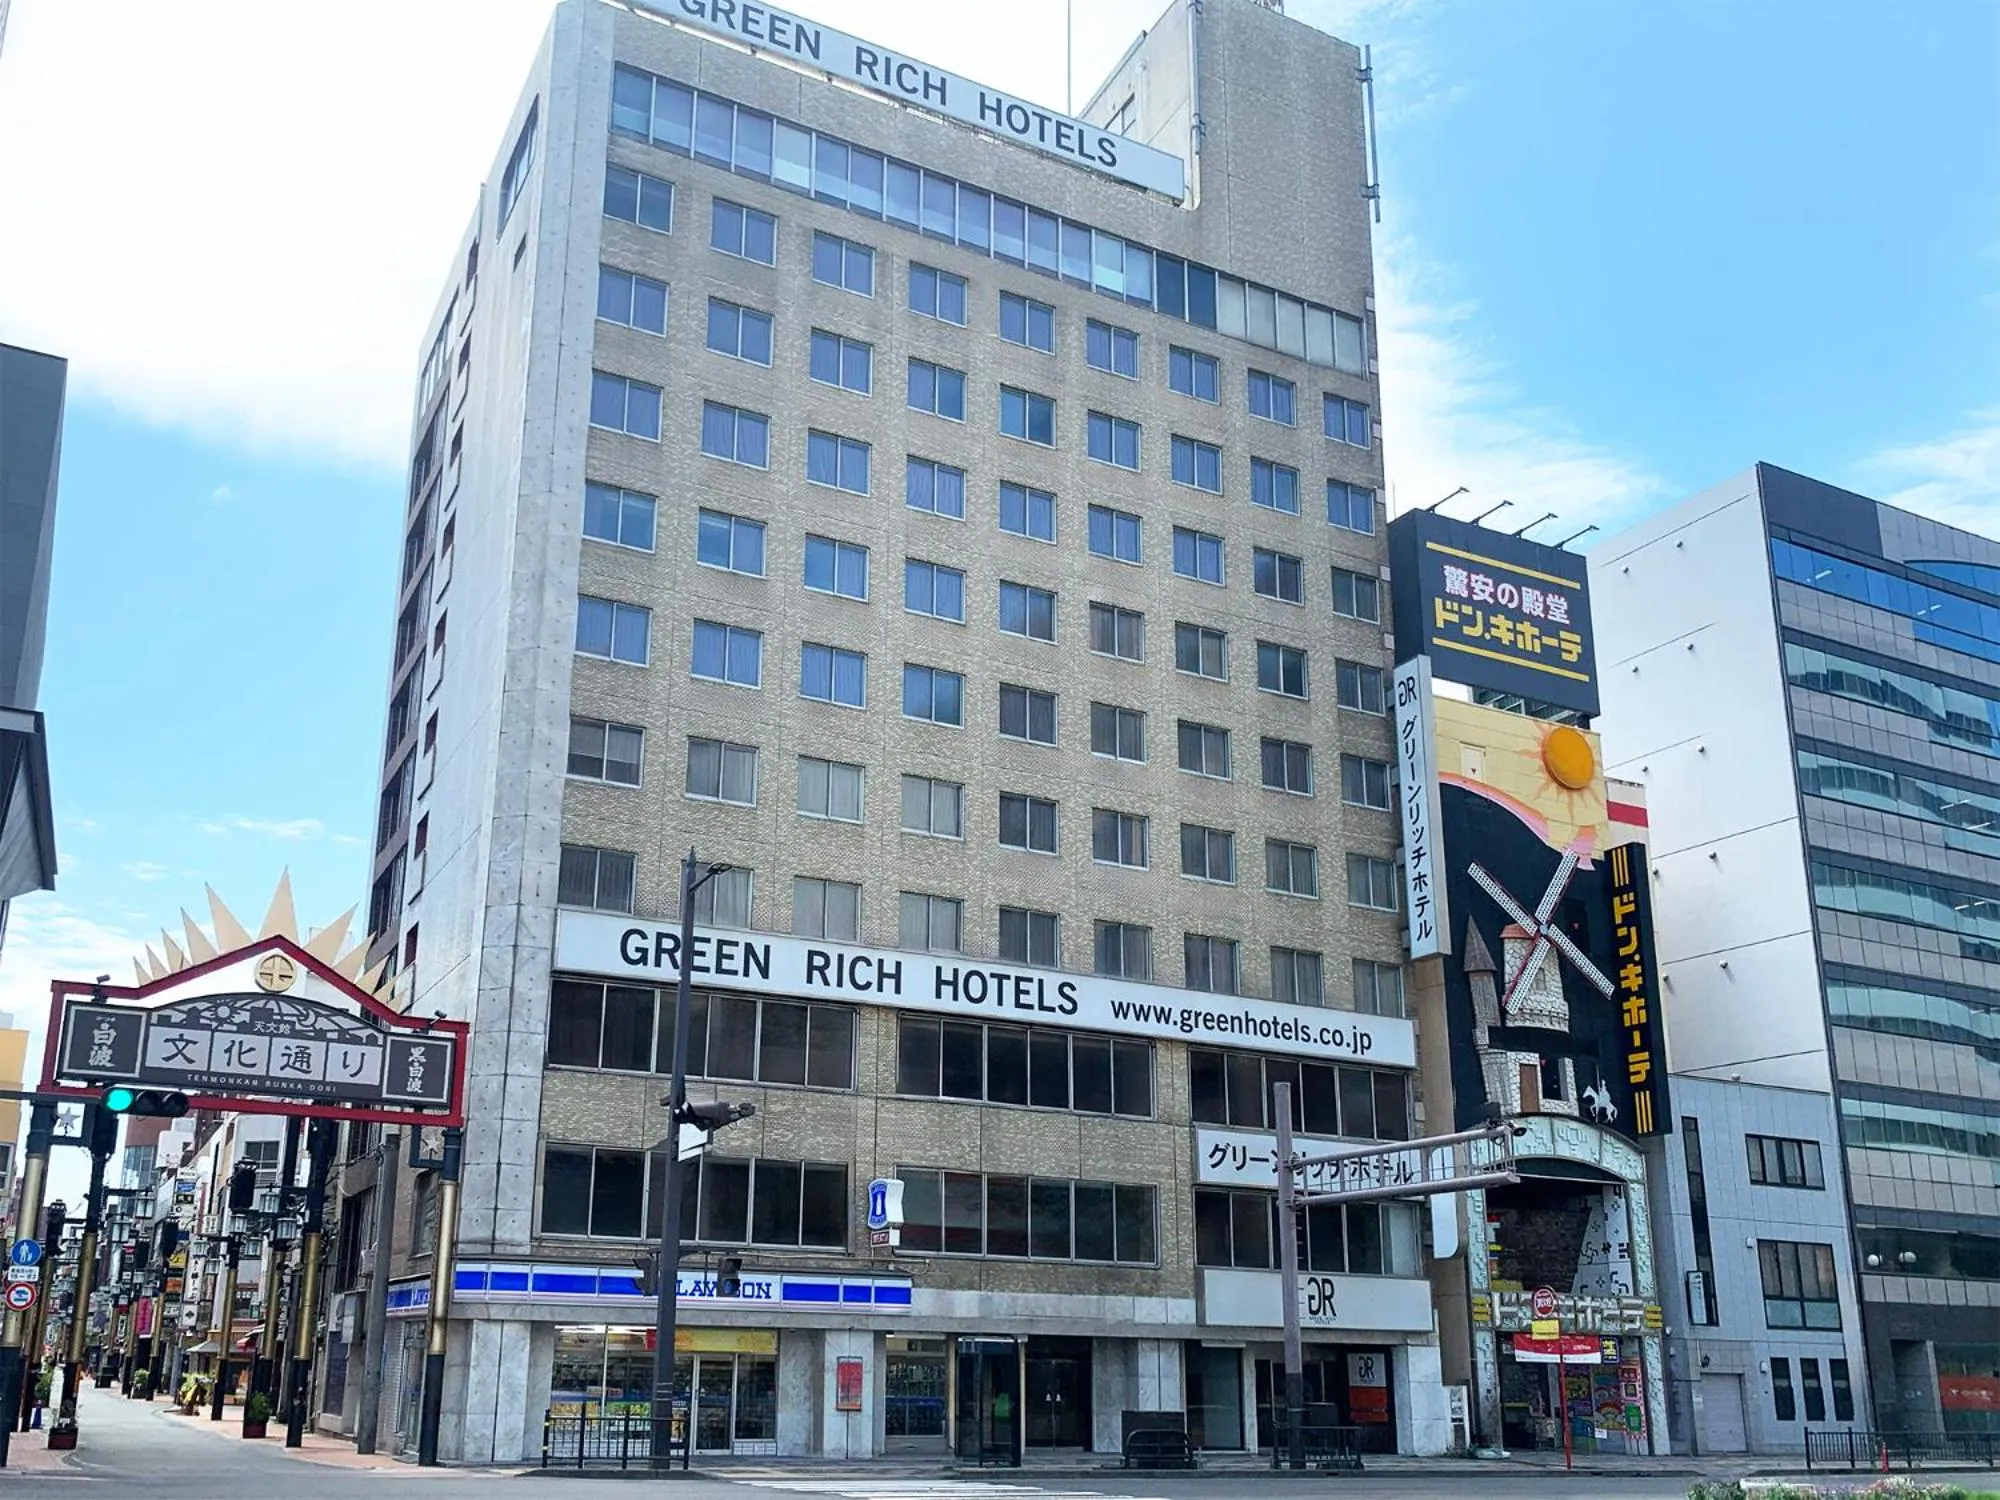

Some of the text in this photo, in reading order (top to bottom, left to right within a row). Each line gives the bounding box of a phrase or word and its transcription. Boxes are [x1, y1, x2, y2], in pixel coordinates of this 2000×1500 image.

[855, 46, 947, 106] RICH
[979, 92, 1117, 168] HOTELS
[1443, 565, 1570, 625] 驚安の殿堂
[1402, 715, 1433, 942] グリーンリッチホテル
[620, 928, 1078, 1016] GREEN RICH HOTELS
[89, 1022, 117, 1068] 白波
[252, 1020, 291, 1035] 天文館
[1111, 999, 1372, 1054] www.greenhotels.co.jp
[161, 1033, 366, 1078] 文化通り
[406, 1046, 427, 1094] 黒白波
[187, 1074, 259, 1087] TENMONKAN
[265, 1081, 303, 1090] BUNKA
